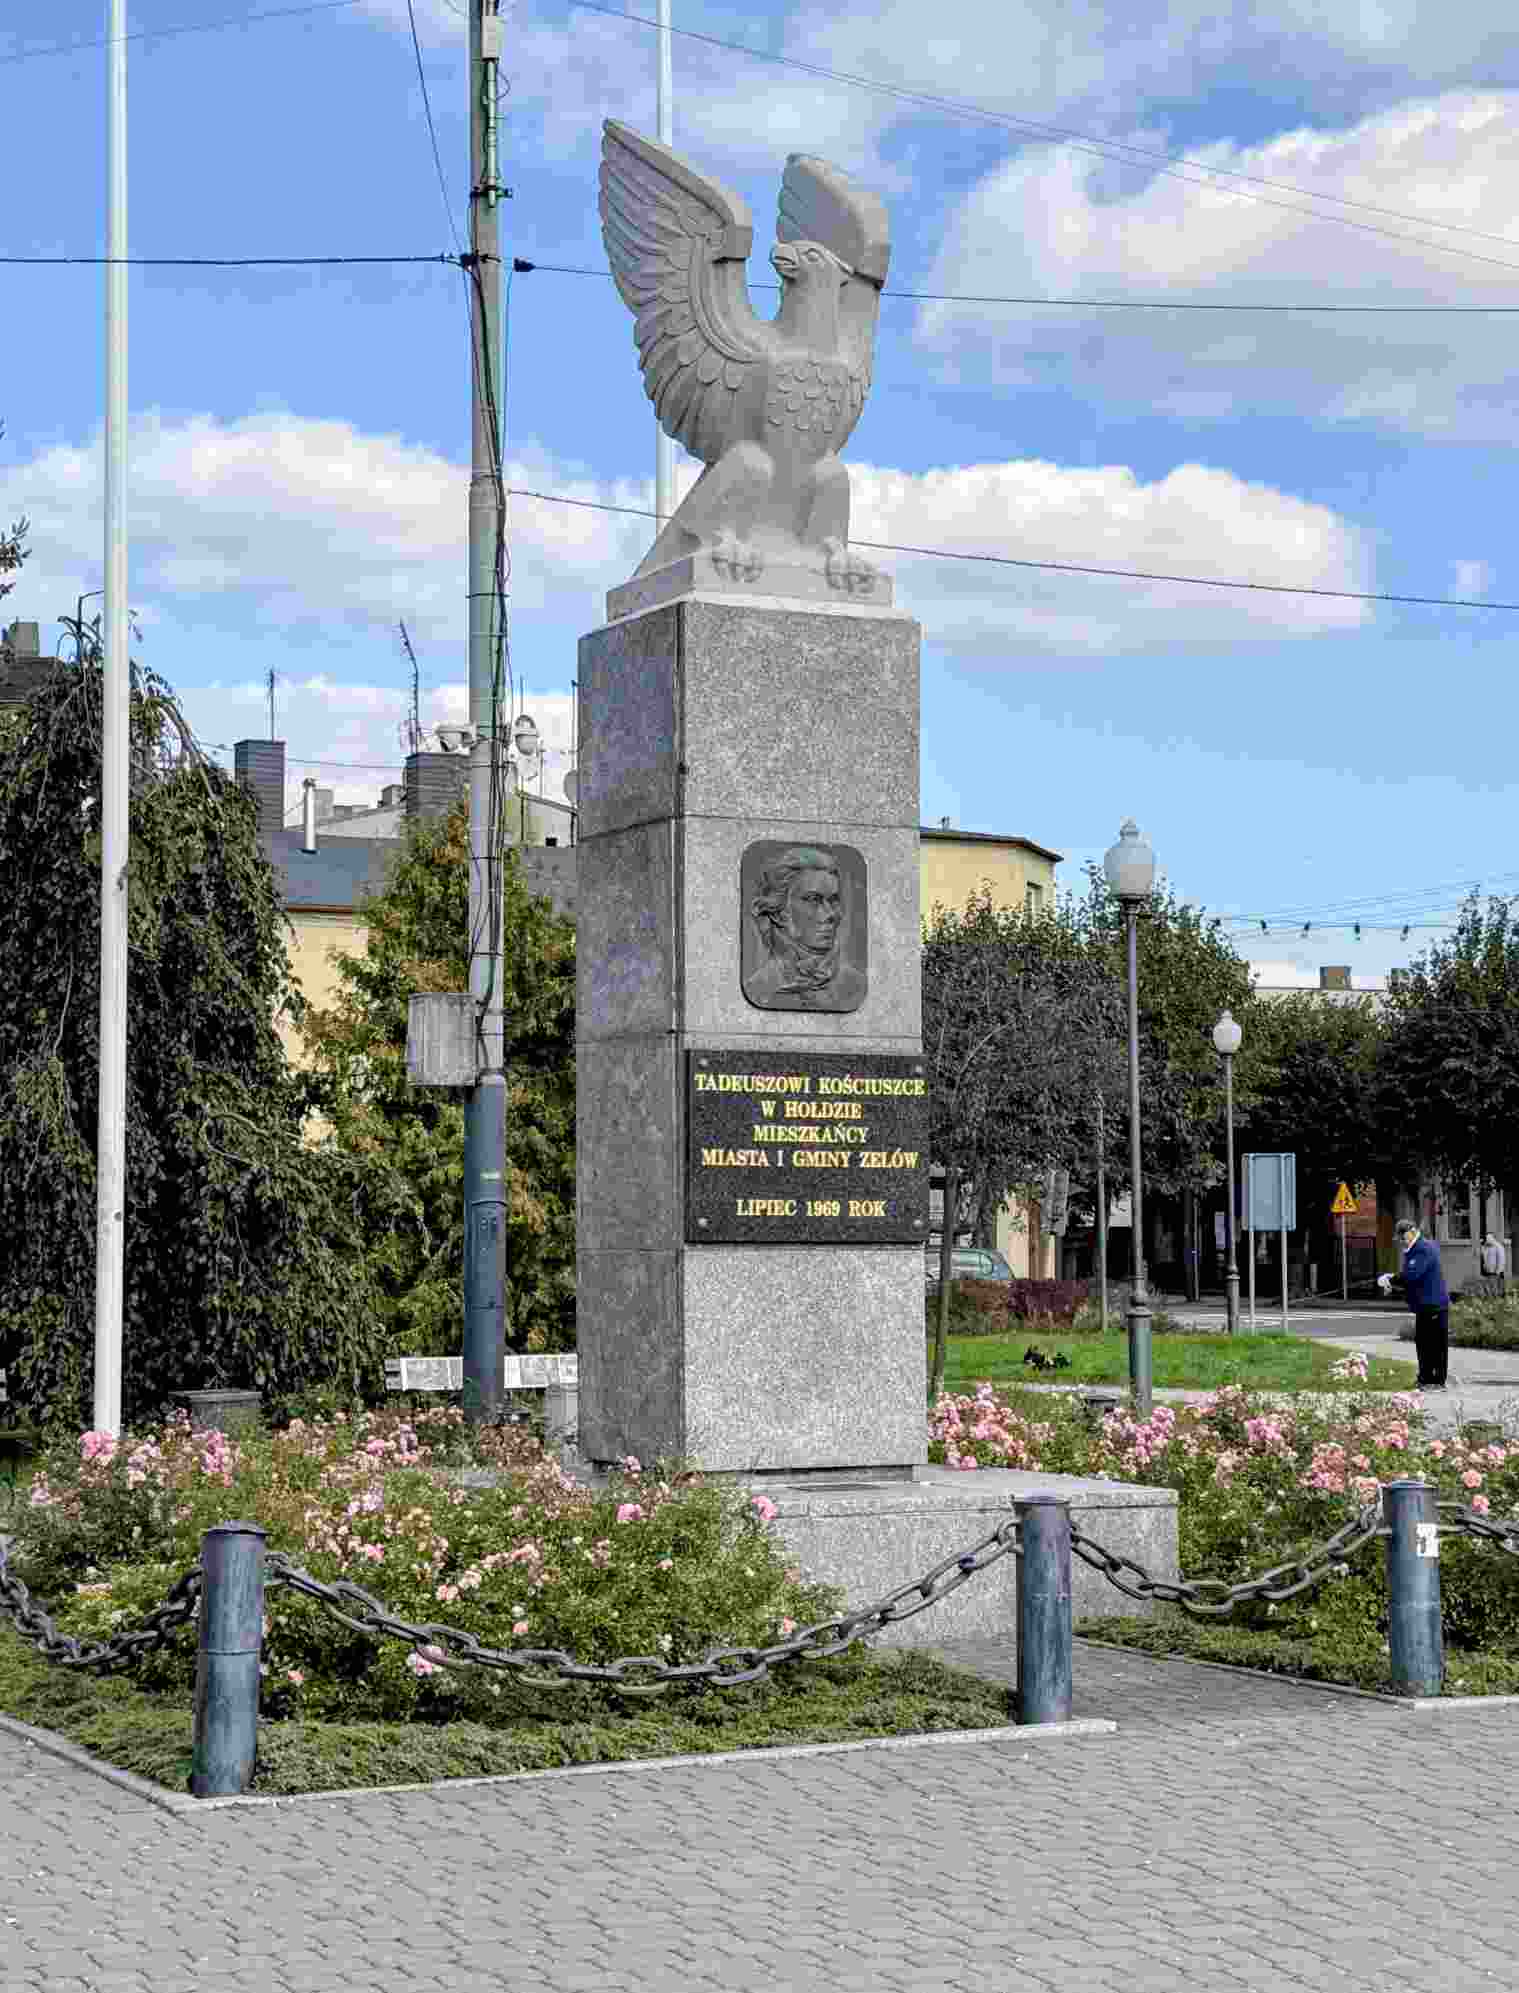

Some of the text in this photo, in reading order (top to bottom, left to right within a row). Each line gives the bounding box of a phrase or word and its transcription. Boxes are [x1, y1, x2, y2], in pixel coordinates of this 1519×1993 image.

[695, 1073, 925, 1095] TADEUSZOWI KOŚCIUSZCE
[761, 1101, 776, 1118] W
[753, 1122, 869, 1143] MIESZKAŃCY
[702, 1147, 919, 1168] MIASTA I GMINY ZELÓW
[736, 1199, 887, 1216] LIPIEC 1969 ROK
